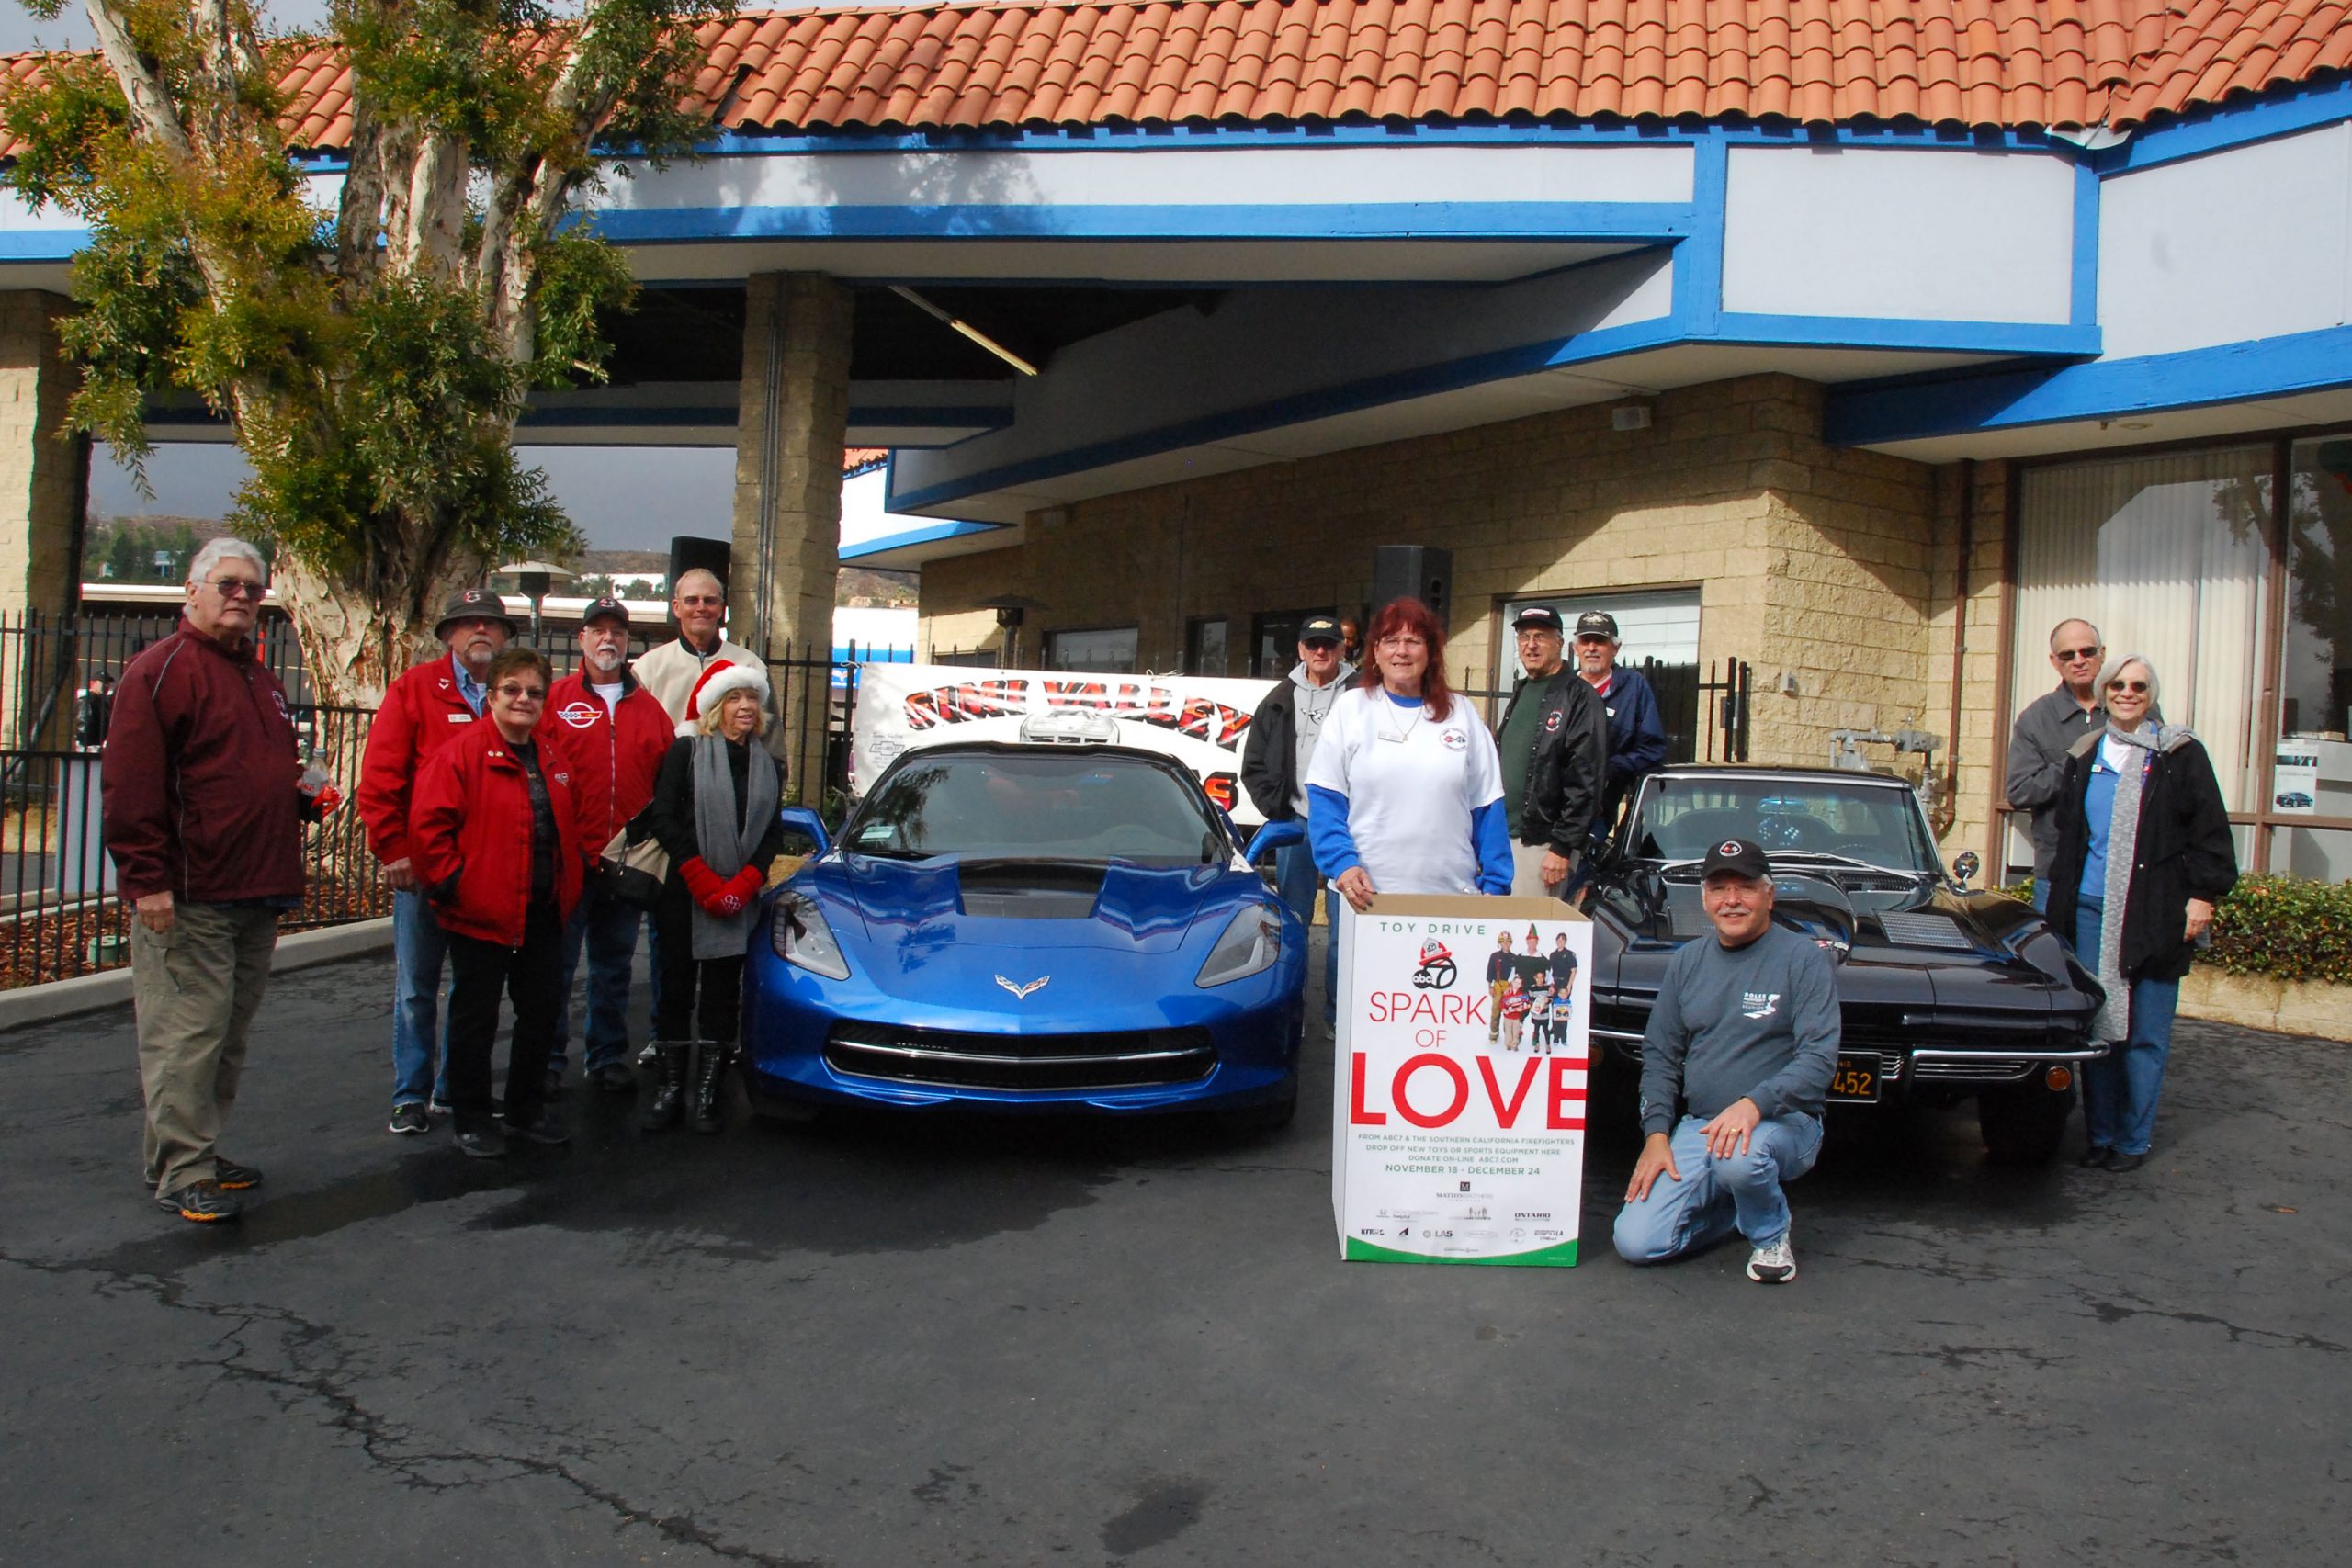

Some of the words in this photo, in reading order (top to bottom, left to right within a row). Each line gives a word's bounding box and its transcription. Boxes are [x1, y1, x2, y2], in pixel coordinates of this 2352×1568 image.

[903, 679, 1030, 730] SIMI
[1043, 681, 1253, 753] VALLEY
[1380, 921, 1417, 933] TOY
[1428, 923, 1487, 935] DRIVE
[1412, 973, 1432, 984] abc
[1369, 991, 1488, 1025] SPARK
[1415, 1029, 1447, 1048] OF
[1350, 1052, 1589, 1130] LOVE
[1833, 1071, 1872, 1095] 452
[1385, 1164, 1444, 1173] NOVEMBER
[1448, 1166, 1458, 1174] 18
[1468, 1167, 1524, 1175] DECEMBER
